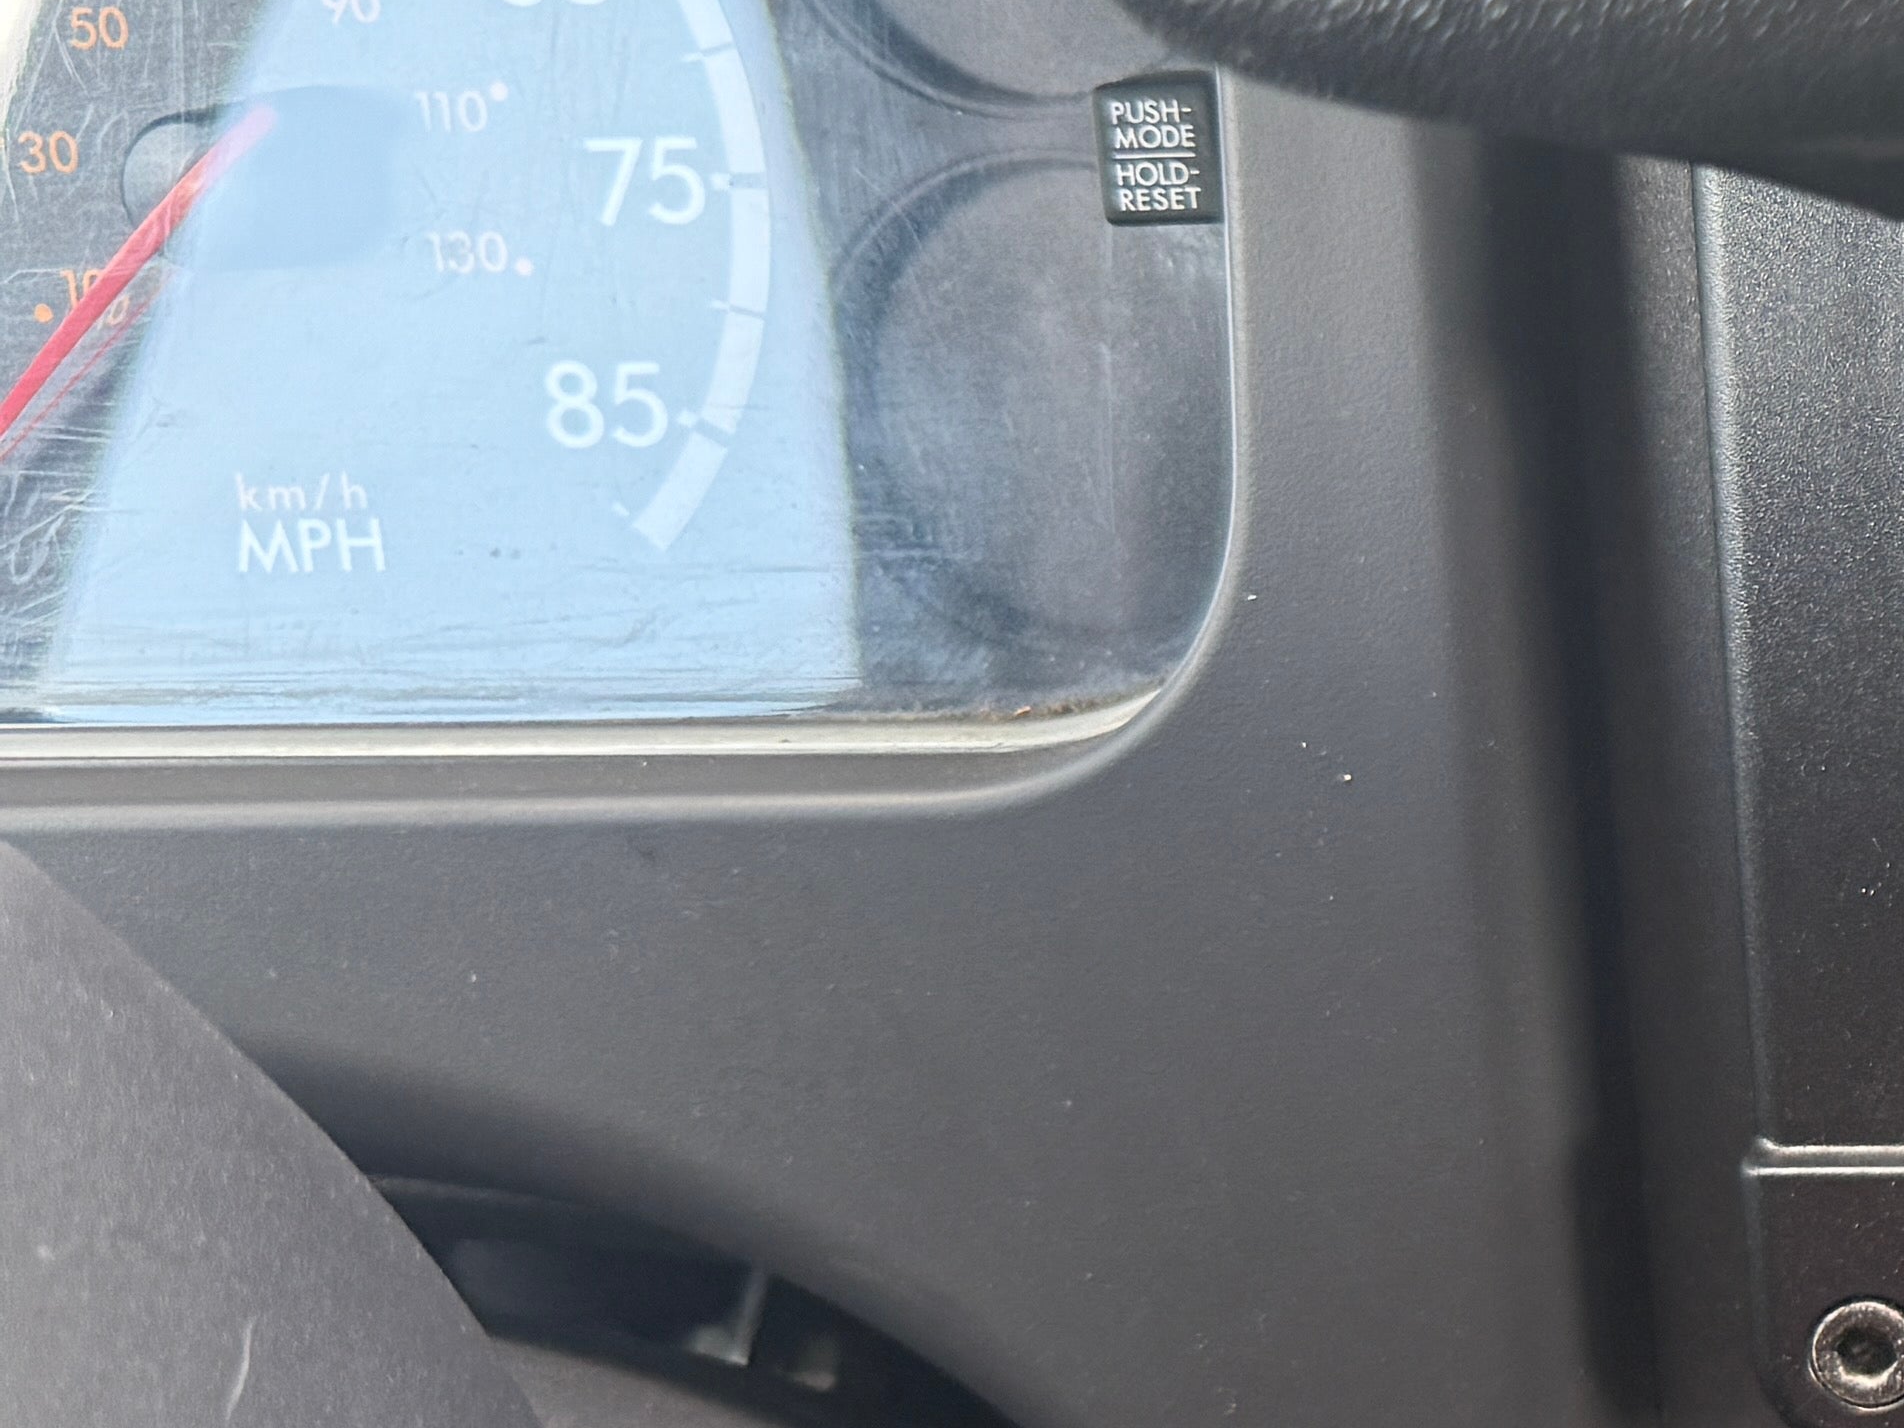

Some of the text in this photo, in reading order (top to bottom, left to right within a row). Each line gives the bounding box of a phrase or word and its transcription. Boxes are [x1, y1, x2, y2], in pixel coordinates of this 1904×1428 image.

[70, 8, 129, 51] 50
[416, 90, 487, 133] 110
[18, 131, 79, 173] 30
[1114, 124, 1196, 149] MODE
[585, 136, 706, 227] 75
[1119, 186, 1201, 211] RESET
[427, 231, 507, 275] 130
[546, 361, 668, 449] 85
[239, 518, 387, 574] MPH
